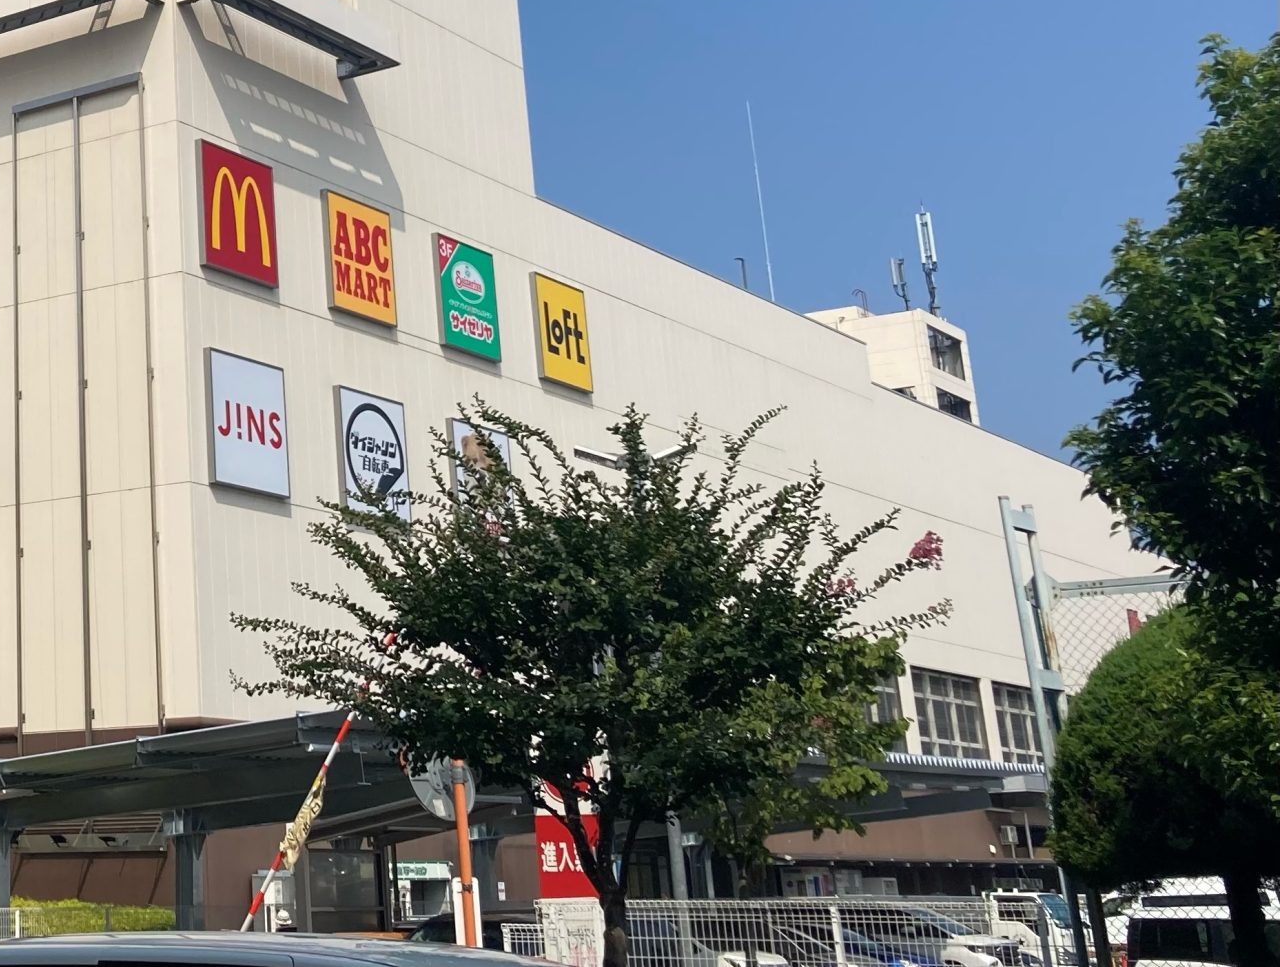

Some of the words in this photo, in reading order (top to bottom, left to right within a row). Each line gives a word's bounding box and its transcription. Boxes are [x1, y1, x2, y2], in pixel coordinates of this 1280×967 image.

[334, 211, 389, 273] ABC
[439, 239, 453, 258] 3F
[335, 260, 391, 308] MART
[450, 311, 493, 344] サイゼリヤ
[350, 432, 397, 459] ダイシャリン
[358, 455, 393, 475] 自転車
[541, 841, 584, 872] 進入
